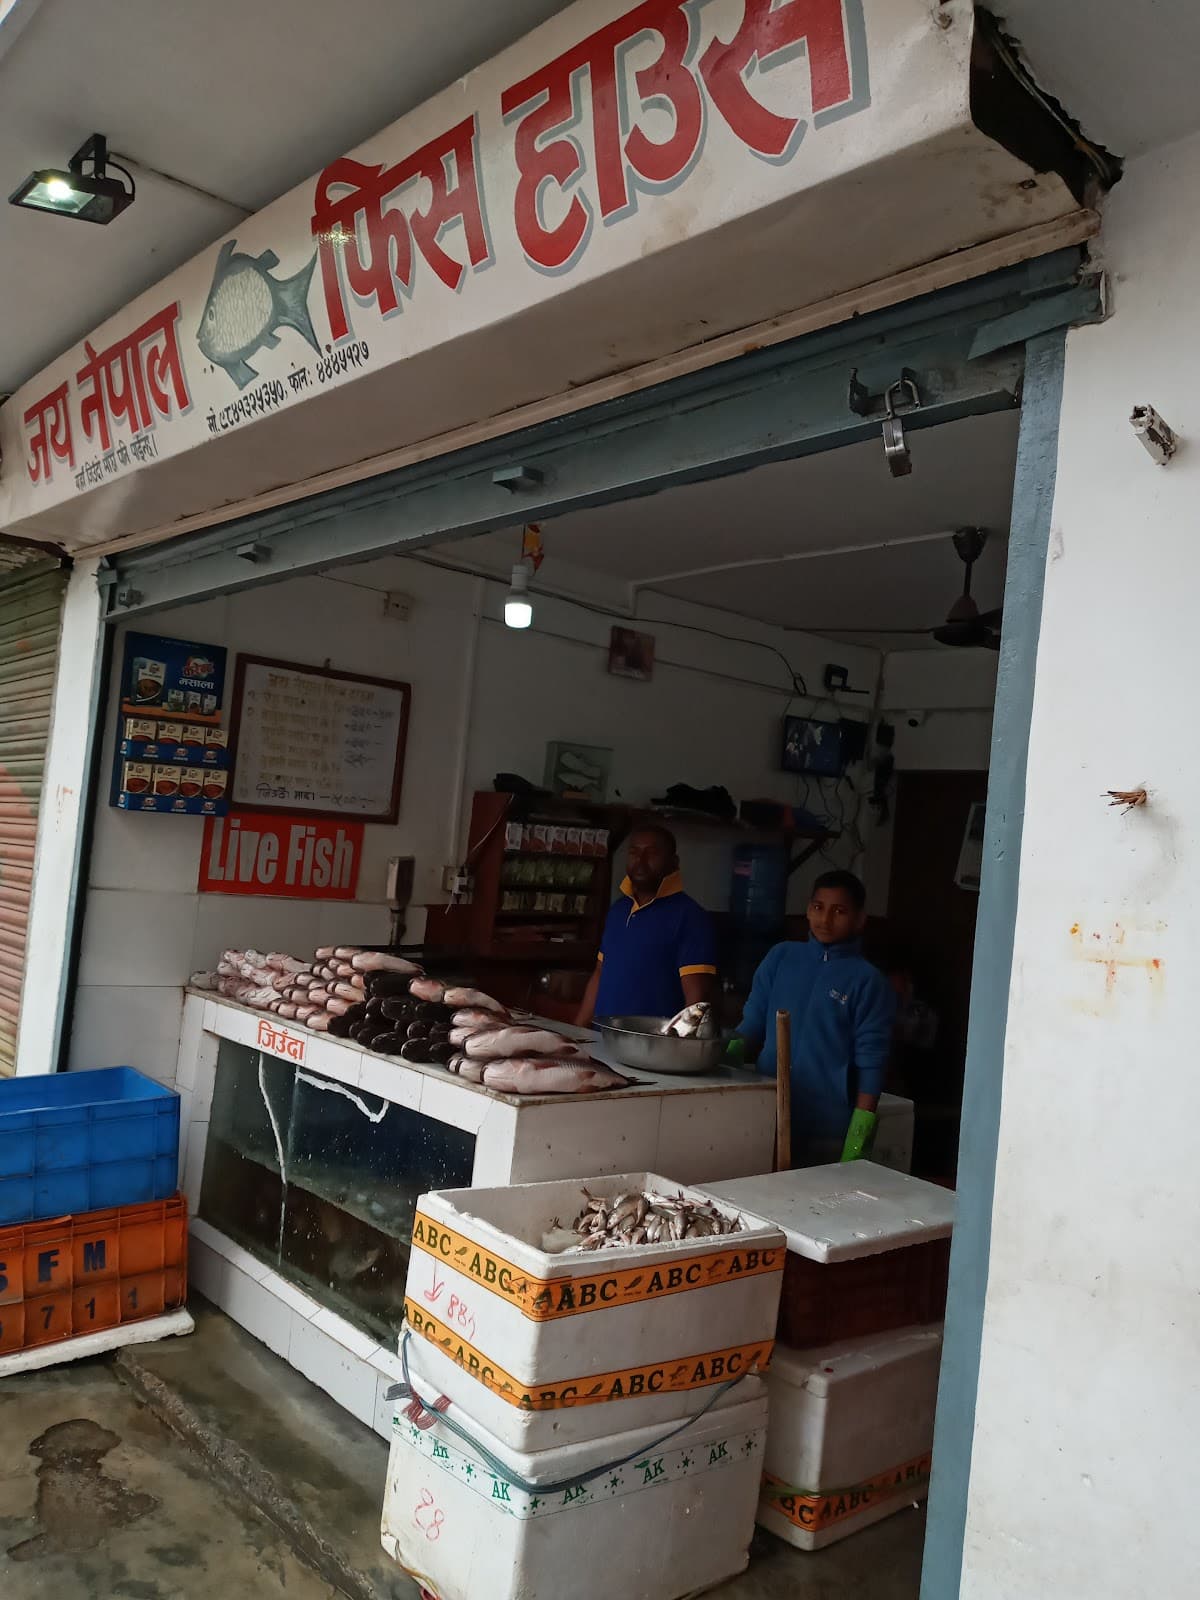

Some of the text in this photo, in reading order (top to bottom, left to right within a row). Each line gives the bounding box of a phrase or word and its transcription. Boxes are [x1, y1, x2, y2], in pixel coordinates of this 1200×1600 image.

[24, 0, 855, 483] जय नेपाल फिस हाउस
[178, 677, 215, 690] मसाला
[208, 816, 354, 889] Live Fish
[414, 1220, 515, 1294] ABC ABC
[647, 1263, 702, 1294] ABC
[728, 1250, 776, 1275] ABC
[607, 1368, 664, 1399] ABC
[692, 1352, 742, 1382] ABC
[491, 1480, 512, 1501] AK
[563, 1440, 729, 1505] AK AK AK
